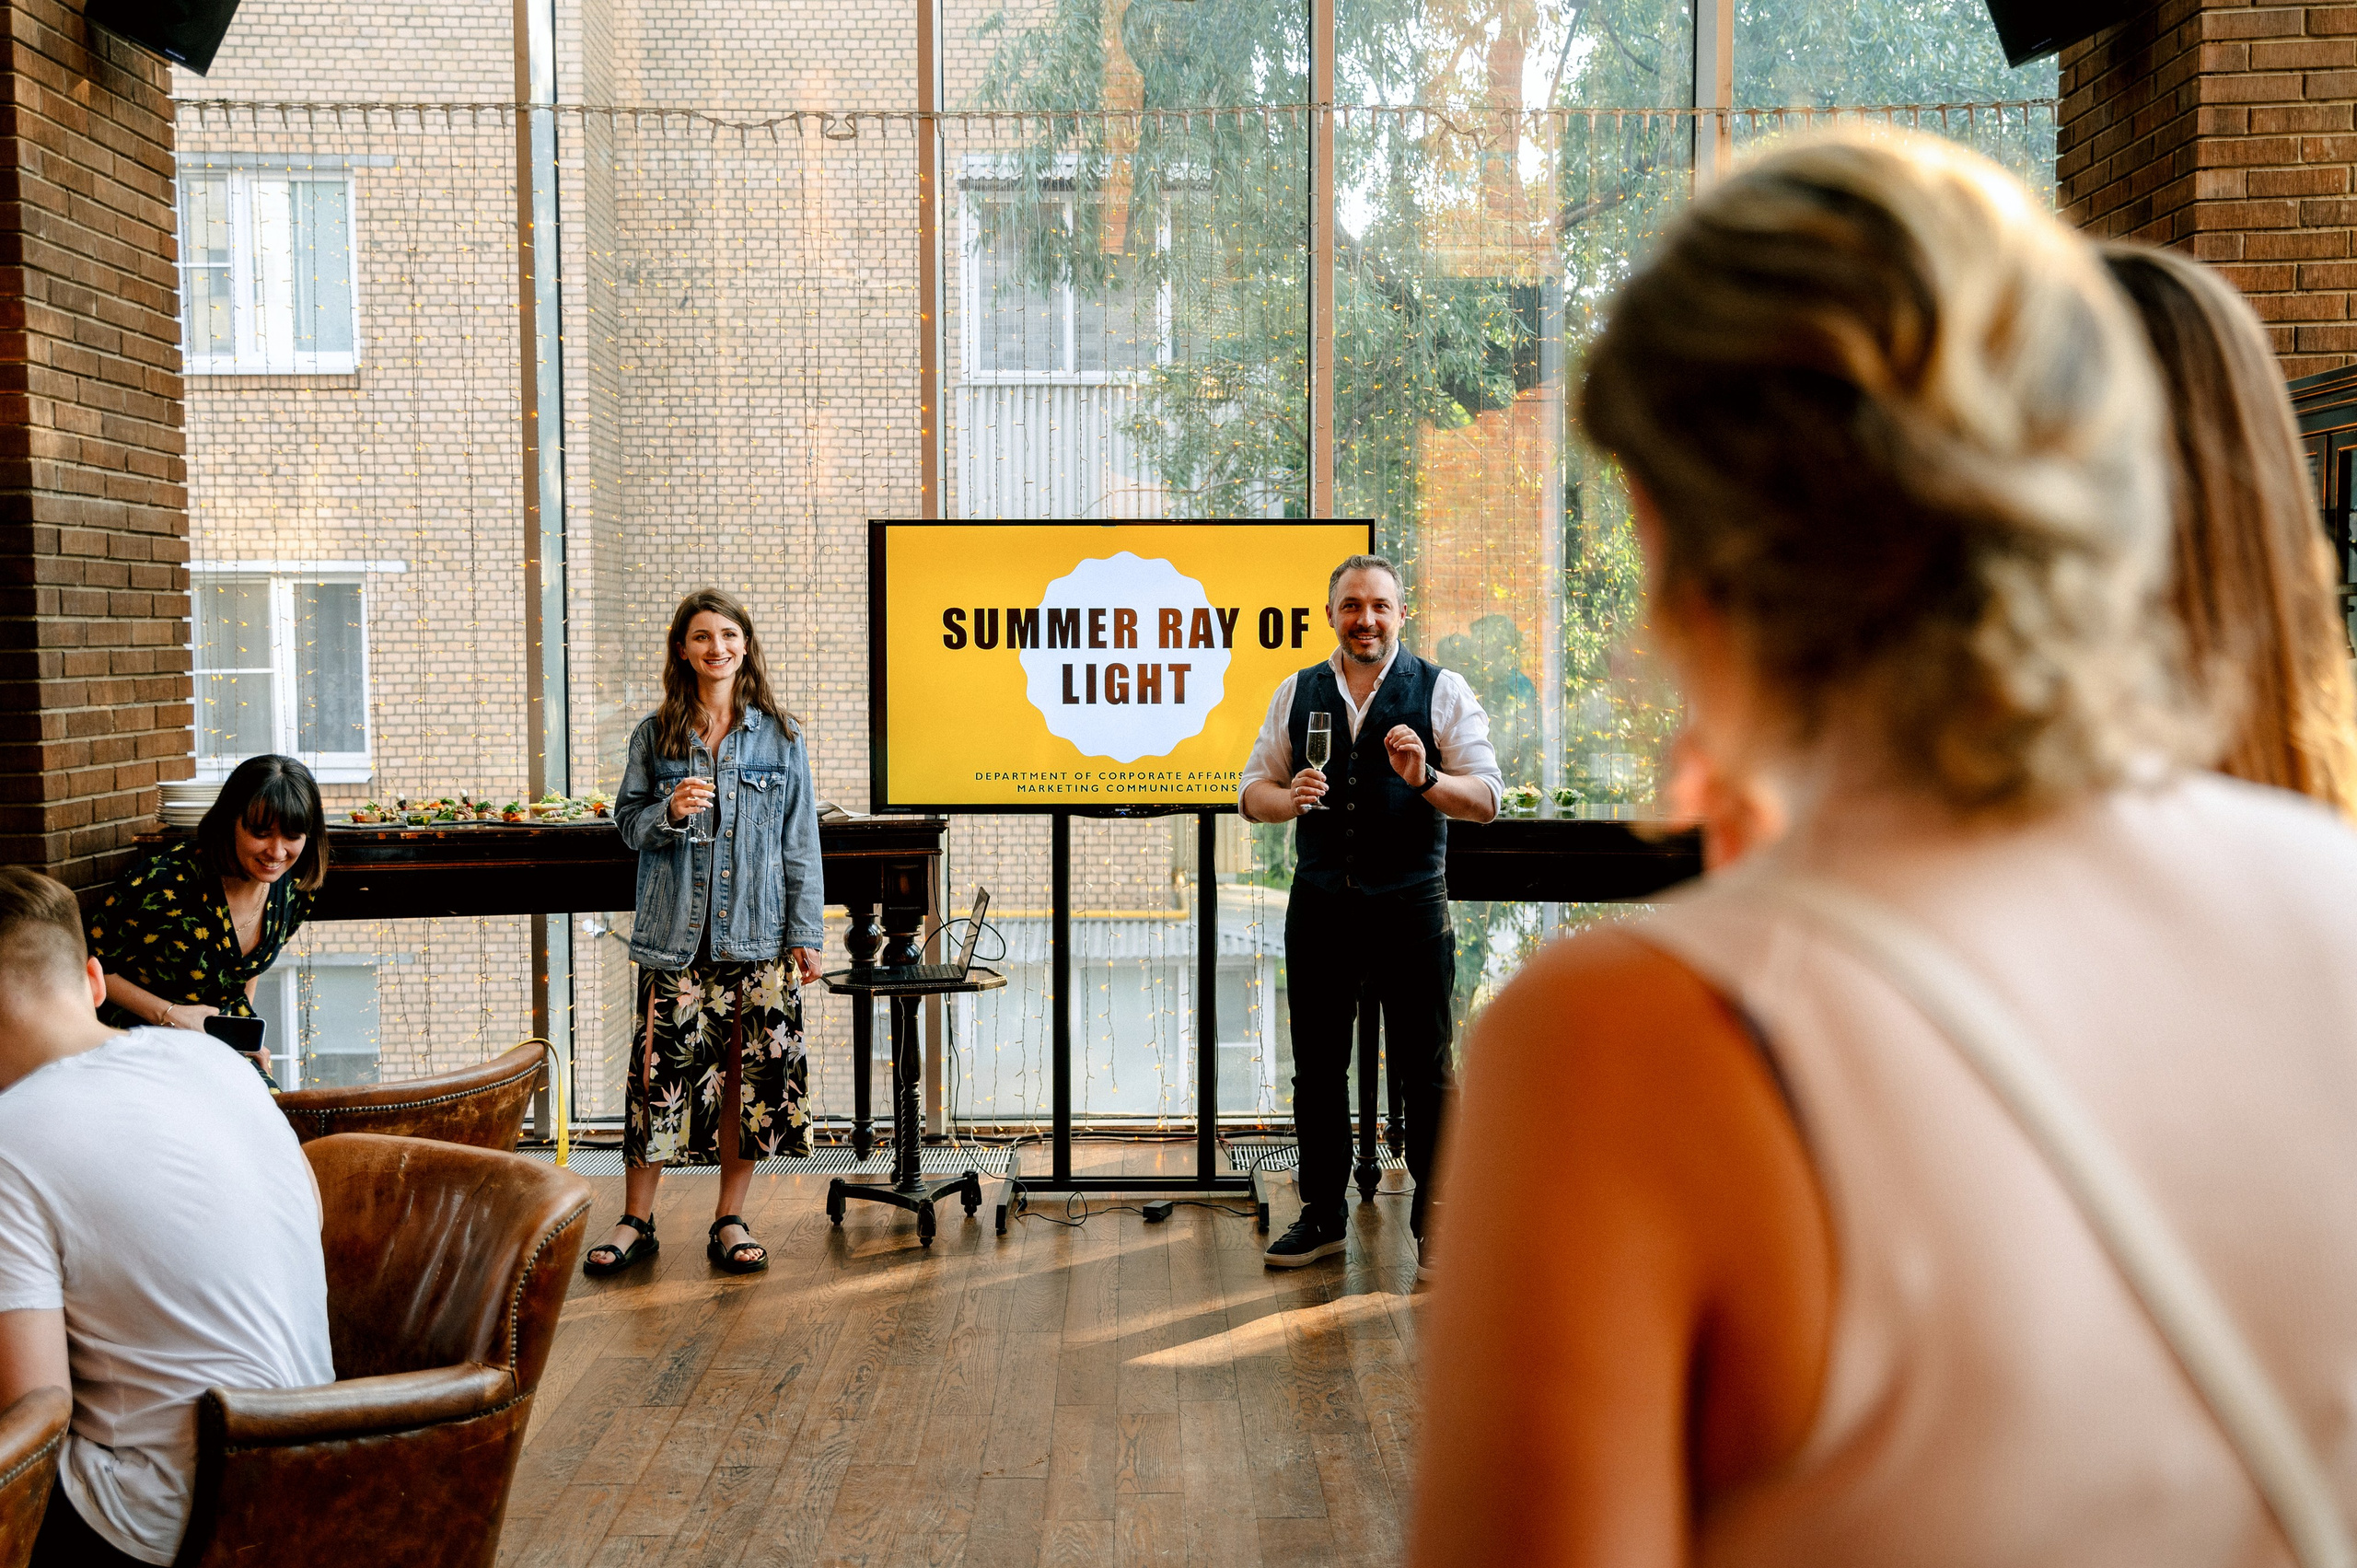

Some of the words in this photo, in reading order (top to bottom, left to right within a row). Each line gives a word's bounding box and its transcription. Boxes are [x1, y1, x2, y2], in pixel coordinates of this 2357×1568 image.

[942, 607, 1138, 650] SUMMER
[1158, 608, 1240, 649] RAY
[1259, 607, 1310, 650] OF
[1062, 663, 1192, 705] LIGHT
[975, 772, 1067, 781] DEPARTMENT
[1074, 772, 1092, 781] OF
[1098, 772, 1182, 781] CORPORATE
[1188, 772, 1243, 780] AFFAIRS
[1016, 784, 1099, 793] MARKETING
[1106, 784, 1237, 793] COMMUNICATIONS
